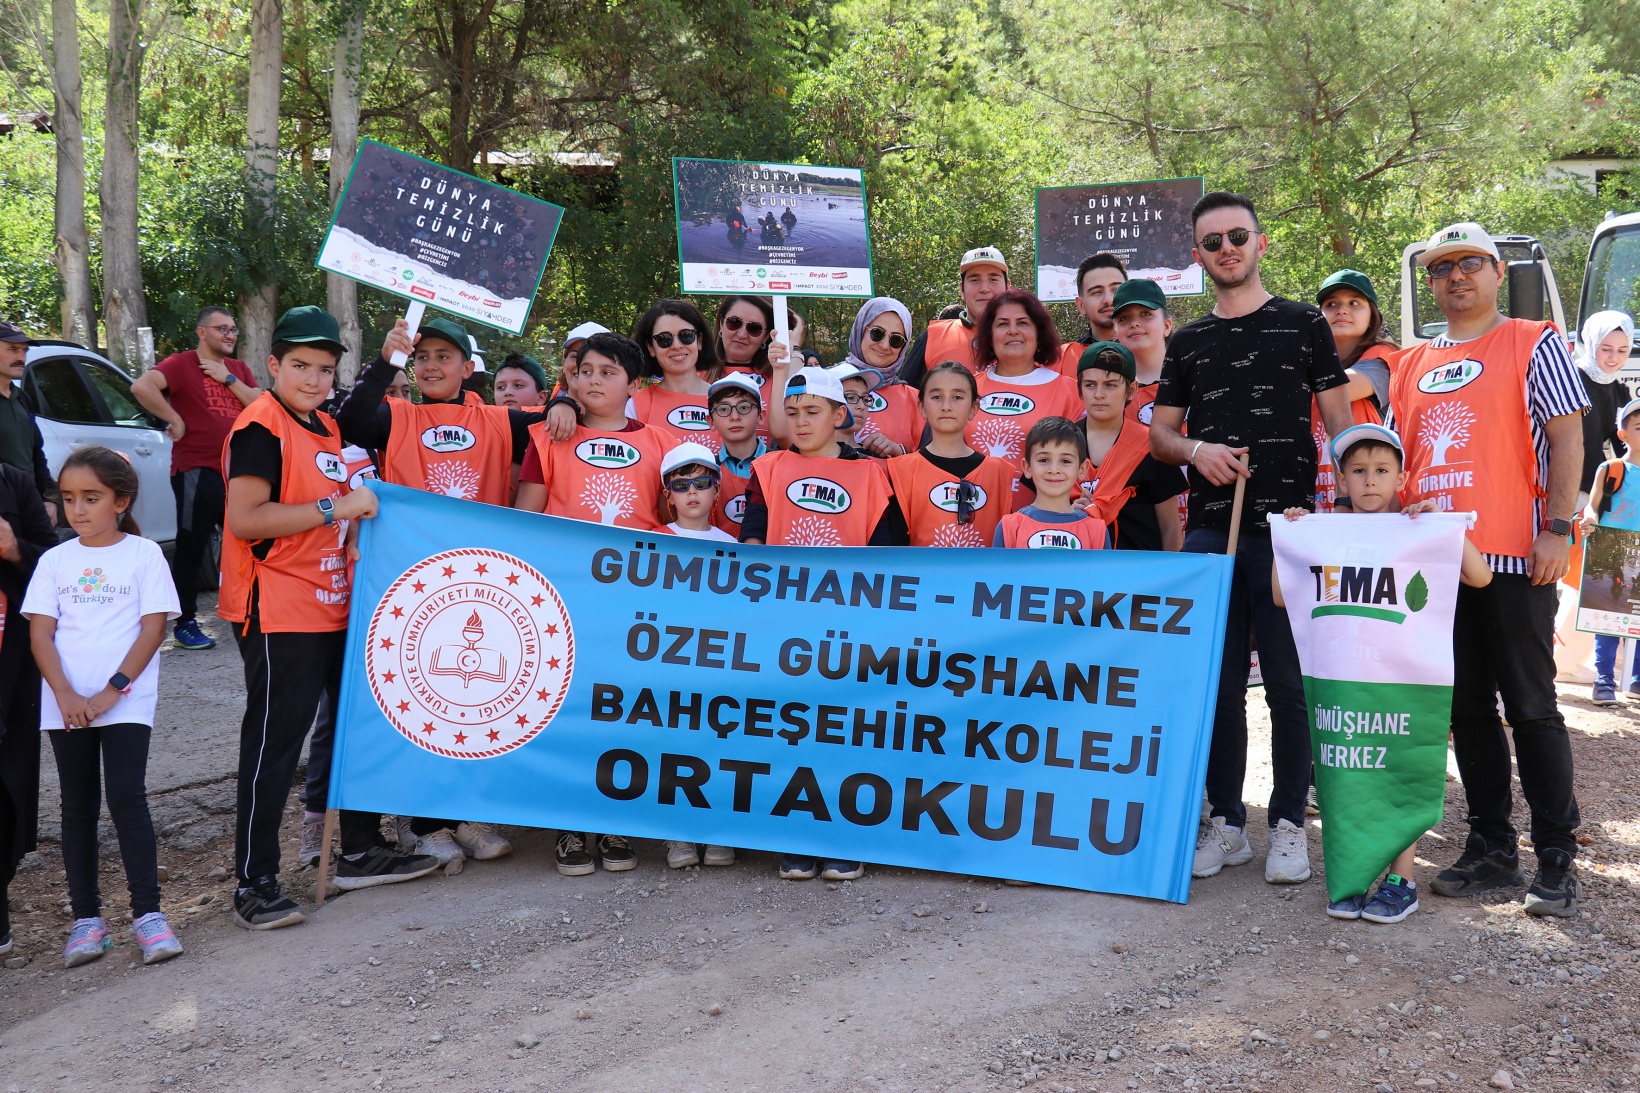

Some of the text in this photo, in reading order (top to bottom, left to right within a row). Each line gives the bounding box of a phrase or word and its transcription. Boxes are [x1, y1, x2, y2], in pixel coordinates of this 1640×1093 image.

[752, 168, 800, 182] DÜNYA
[420, 176, 491, 212] DÜNYA
[740, 182, 813, 196] TEMİZLİK
[760, 196, 797, 207] GÜNÜ
[1088, 195, 1147, 209] DÜNYA
[395, 187, 505, 236] TEMİZLİK
[1073, 209, 1163, 226] TEMİZLİK
[416, 214, 473, 243] GÜNÜ
[1095, 225, 1140, 241] GÜNÜ
[1439, 231, 1460, 242] TEMA
[973, 251, 989, 259] TEMA
[809, 271, 828, 279] Beybi
[458, 290, 481, 302] Beybi
[1432, 365, 1463, 383] TEMA
[991, 396, 1021, 409] TEMA
[433, 430, 461, 442] TEMA
[589, 443, 625, 458] TEMA
[1417, 468, 1474, 495] TÜRKİYE
[801, 483, 836, 502] TEMA
[1039, 534, 1069, 547] TEMA
[57, 584, 131, 595] Let's do it!
[590, 540, 922, 612] GÜMÜŞHANE
[971, 581, 1195, 637] MERKEZ
[1309, 565, 1398, 605] TEMA
[71, 594, 114, 605] Türkiye
[405, 585, 469, 660] CUMHURİYETİ
[510, 607, 536, 655] EĞİTİM
[625, 611, 1140, 708] ÖZEL GÜMÜŞHANE
[407, 666, 449, 715] TÜRKİYE
[478, 660, 535, 719] BAKANLIĞI
[590, 683, 1162, 778] BAHÇEŞEHİR KOLEJİ
[1320, 742, 1387, 769] MERKEZ
[594, 748, 1146, 856] ORTAOKULU
